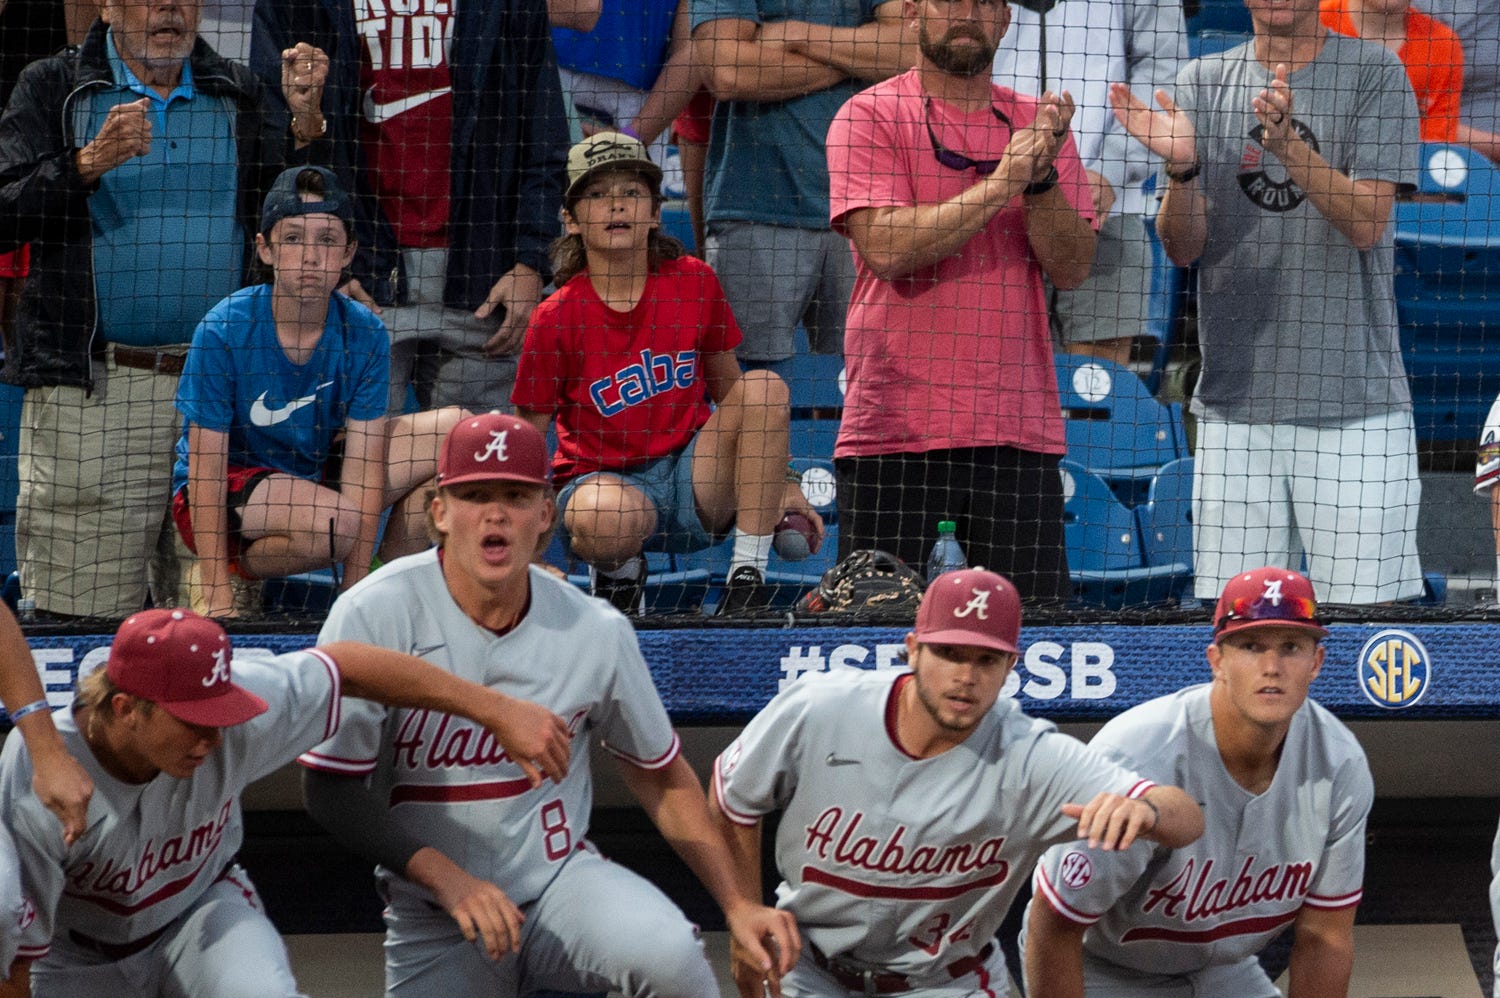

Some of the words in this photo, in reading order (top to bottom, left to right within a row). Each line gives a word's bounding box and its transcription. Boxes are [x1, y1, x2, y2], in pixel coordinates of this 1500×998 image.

[474, 430, 508, 463] A
[953, 588, 990, 621] A
[203, 648, 228, 687] A
[1368, 639, 1421, 702] SEC
[540, 799, 572, 862] 8
[806, 806, 1006, 875] Alabama
[1061, 853, 1092, 887] SEC
[1143, 855, 1314, 922] Alabam
